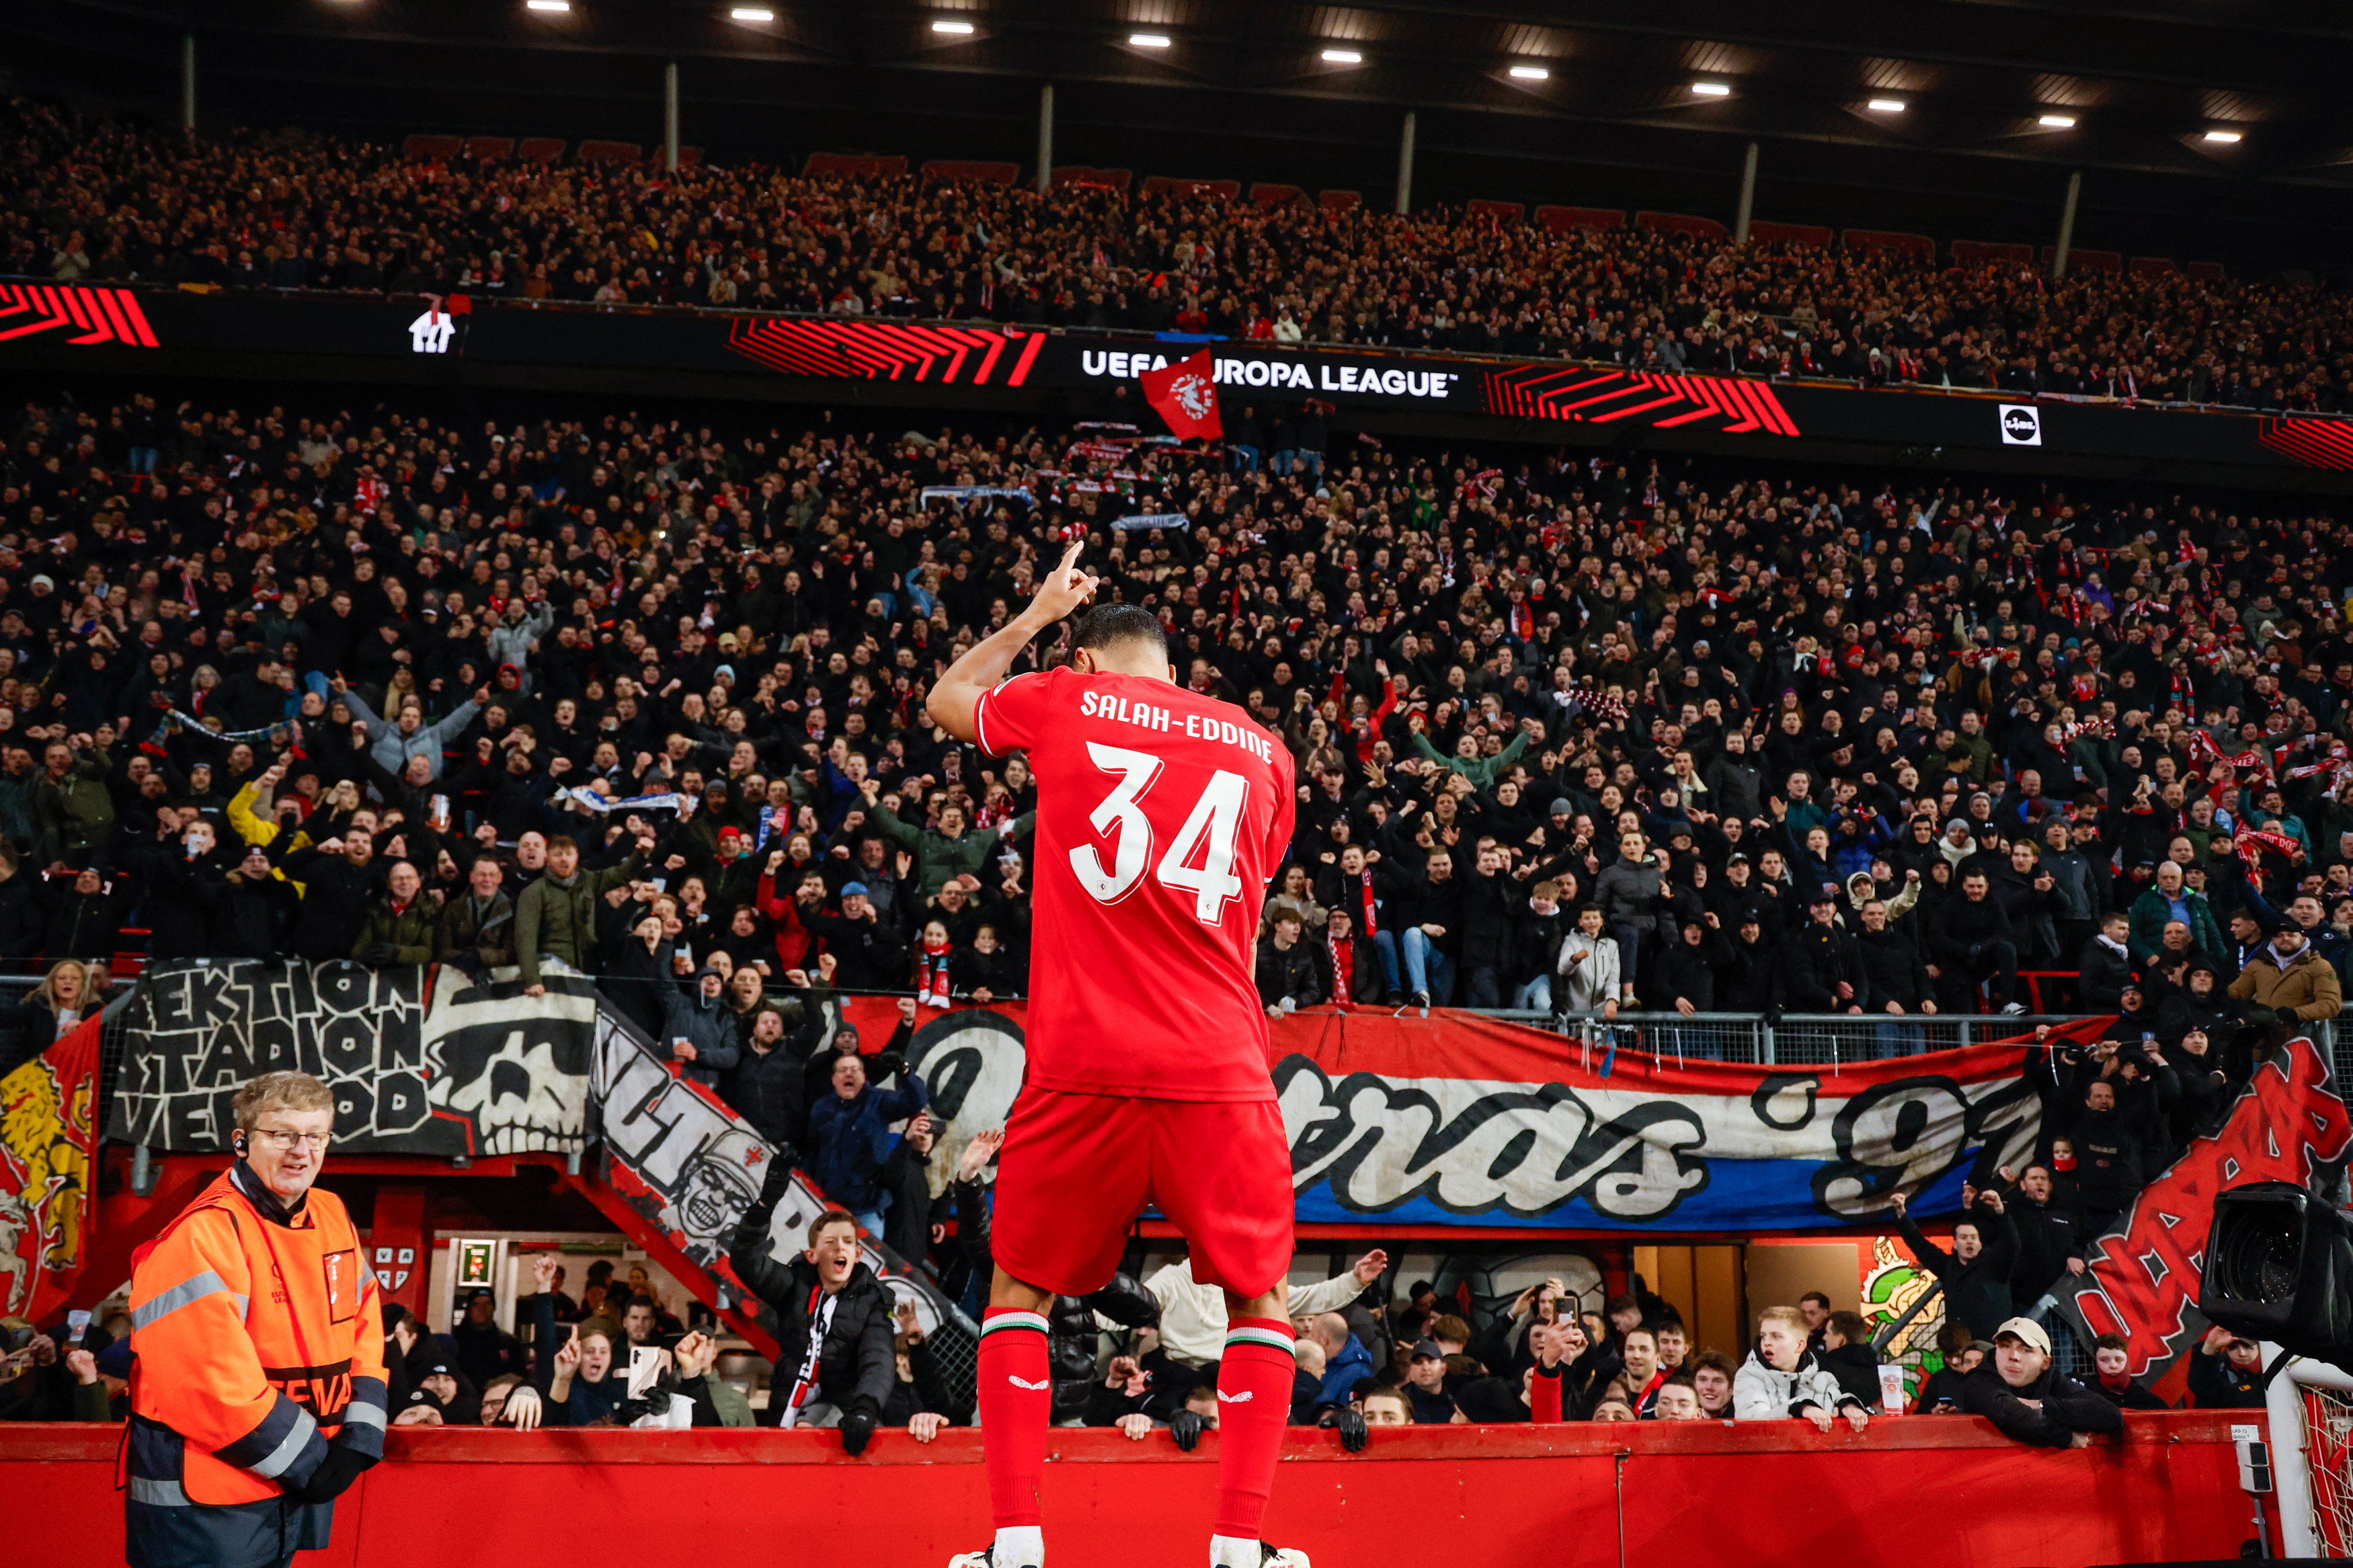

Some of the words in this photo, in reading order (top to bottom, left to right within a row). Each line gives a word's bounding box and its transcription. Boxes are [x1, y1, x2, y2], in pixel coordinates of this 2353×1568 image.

[1082, 349, 1168, 379] UEFA
[1181, 356, 1314, 389] ROPA
[1080, 691, 1273, 765] SALAH-EDDINE
[1069, 741, 1249, 927] 34
[113, 1072, 433, 1151] VEOD
